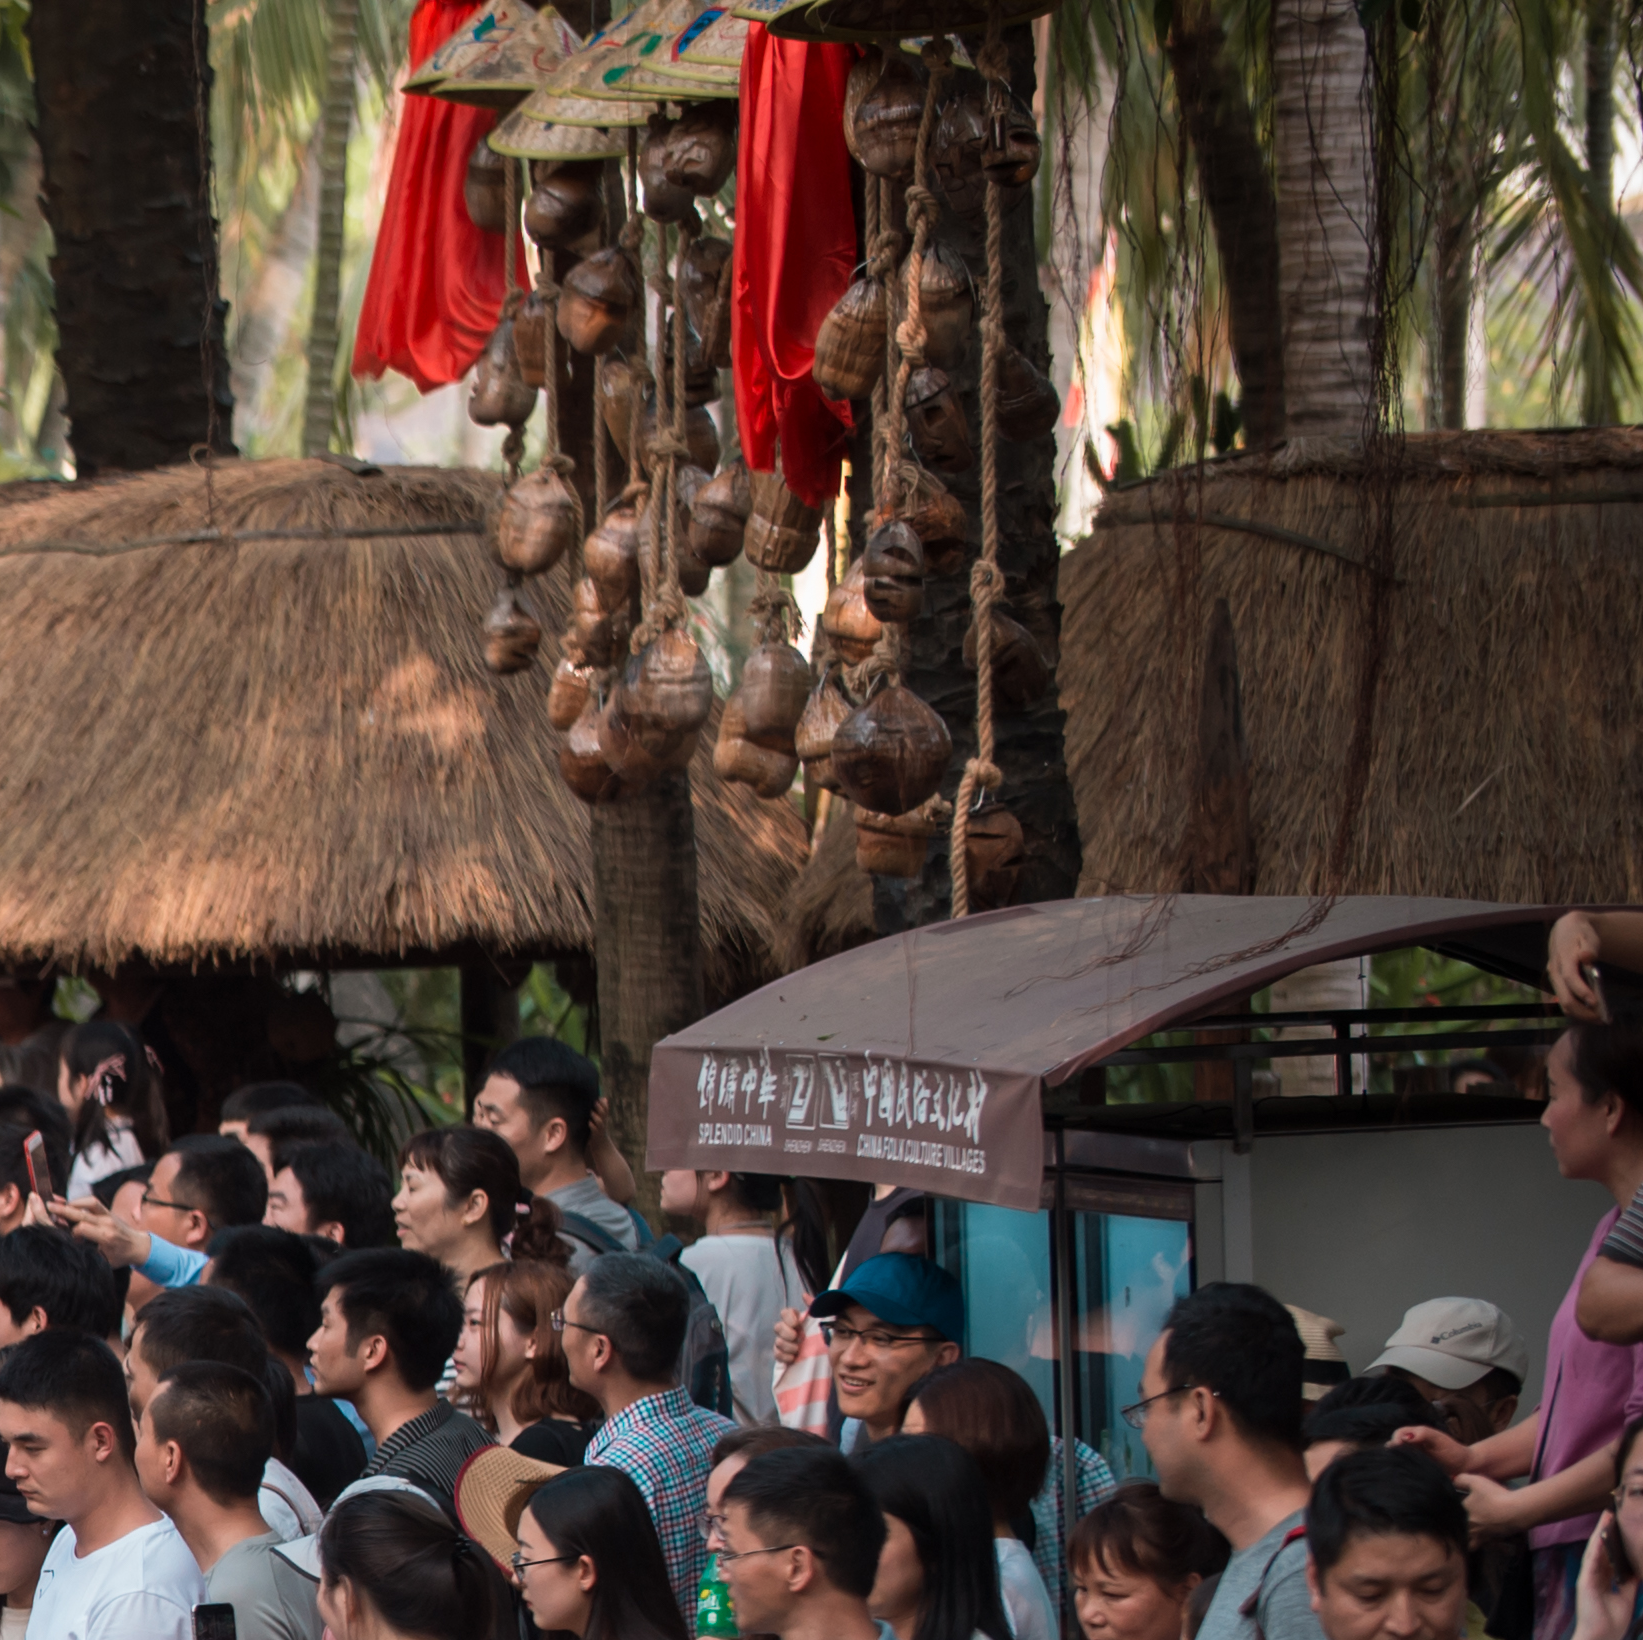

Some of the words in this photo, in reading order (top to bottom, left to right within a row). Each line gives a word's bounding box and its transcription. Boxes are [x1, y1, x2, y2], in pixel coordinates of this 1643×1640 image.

[698, 1122, 743, 1146] SPLENDID
[744, 1123, 772, 1147] CHINA
[857, 1133, 883, 1159] CHINA
[883, 1136, 905, 1162] FOLK
[904, 1139, 943, 1168] CULTURE
[943, 1144, 987, 1175] VILLAGES
[1440, 1322, 1483, 1341] Columbia
